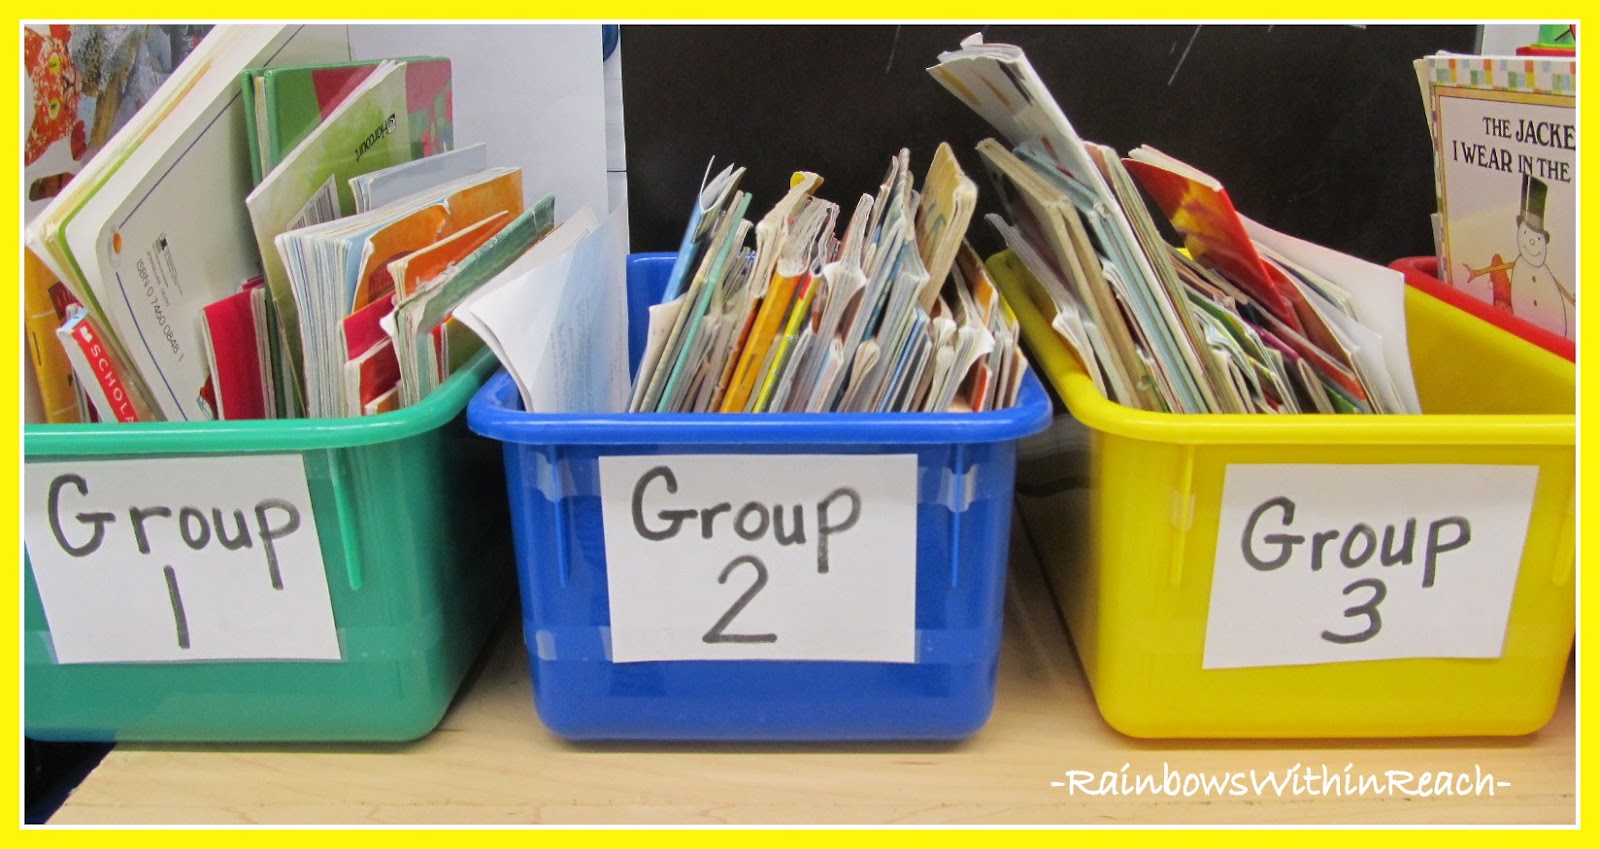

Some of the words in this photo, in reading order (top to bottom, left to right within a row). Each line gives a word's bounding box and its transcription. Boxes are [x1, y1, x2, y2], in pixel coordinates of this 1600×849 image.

[355, 119, 388, 162] Harcourt
[1453, 140, 1458, 161] I
[1461, 142, 1513, 173] WEAR
[1518, 154, 1533, 175] IN
[1537, 157, 1571, 183] THE
[1482, 117, 1512, 139] THE
[1515, 119, 1576, 151] JACKE
[136, 258, 151, 288] ISBN
[48, 473, 301, 591] Group
[631, 465, 862, 574] Group
[1241, 496, 1471, 588] Group
[163, 565, 191, 650] 1
[702, 555, 778, 644] 2
[1321, 578, 1387, 644] 3
